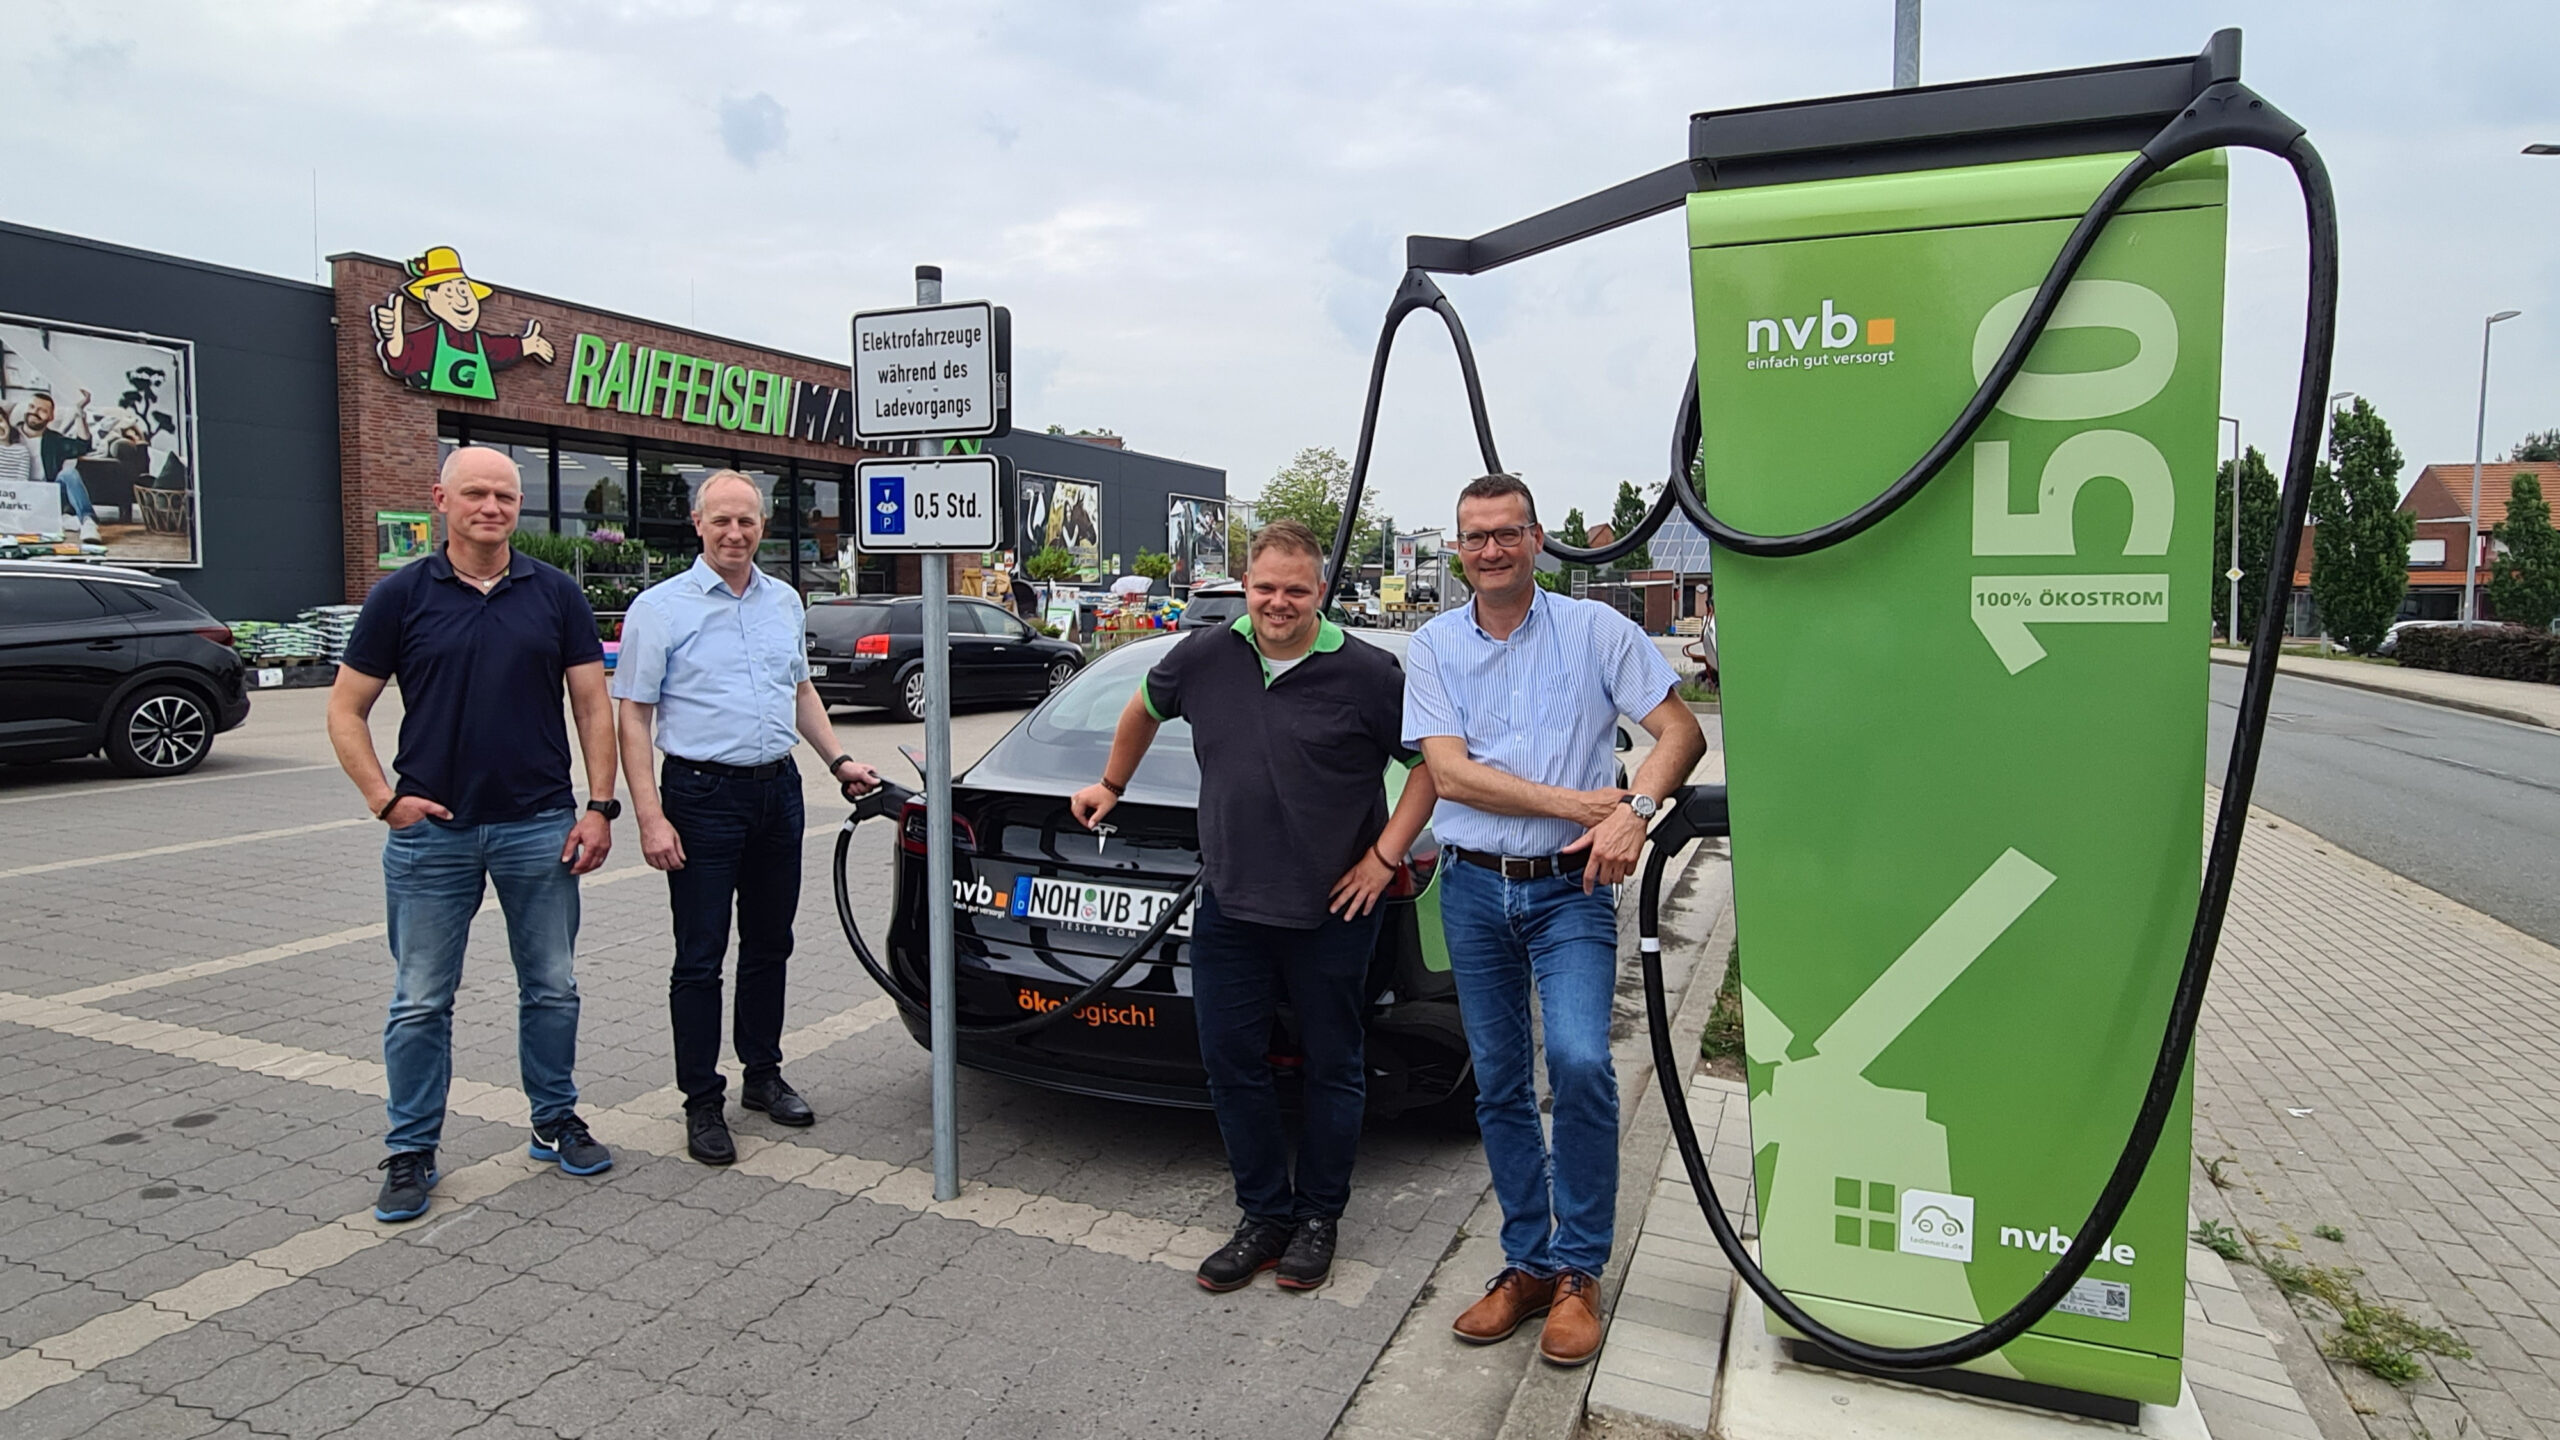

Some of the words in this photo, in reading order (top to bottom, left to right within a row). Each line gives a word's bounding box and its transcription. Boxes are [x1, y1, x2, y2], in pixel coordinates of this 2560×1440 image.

[1748, 299, 1858, 353] nvb
[863, 328, 982, 352] Elektrofahrzeuge
[878, 361, 936, 384] während
[944, 360, 968, 379] des
[1747, 355, 1799, 370] einfach
[1803, 355, 1829, 369] gut
[1833, 350, 1895, 365] versorgt
[448, 358, 478, 389] G
[566, 333, 792, 436] RAIFFEISEN
[876, 397, 972, 420] Ladevorgangs
[1971, 279, 2178, 676] 150
[914, 493, 939, 520] 0,5
[947, 492, 982, 518] Std.
[1976, 592, 2032, 607] 100%
[2039, 589, 2163, 606] ÖKOSTROM
[1030, 882, 1081, 918] NOH
[1100, 889, 1131, 923] VB
[1060, 921, 1137, 938] TESLA.COM
